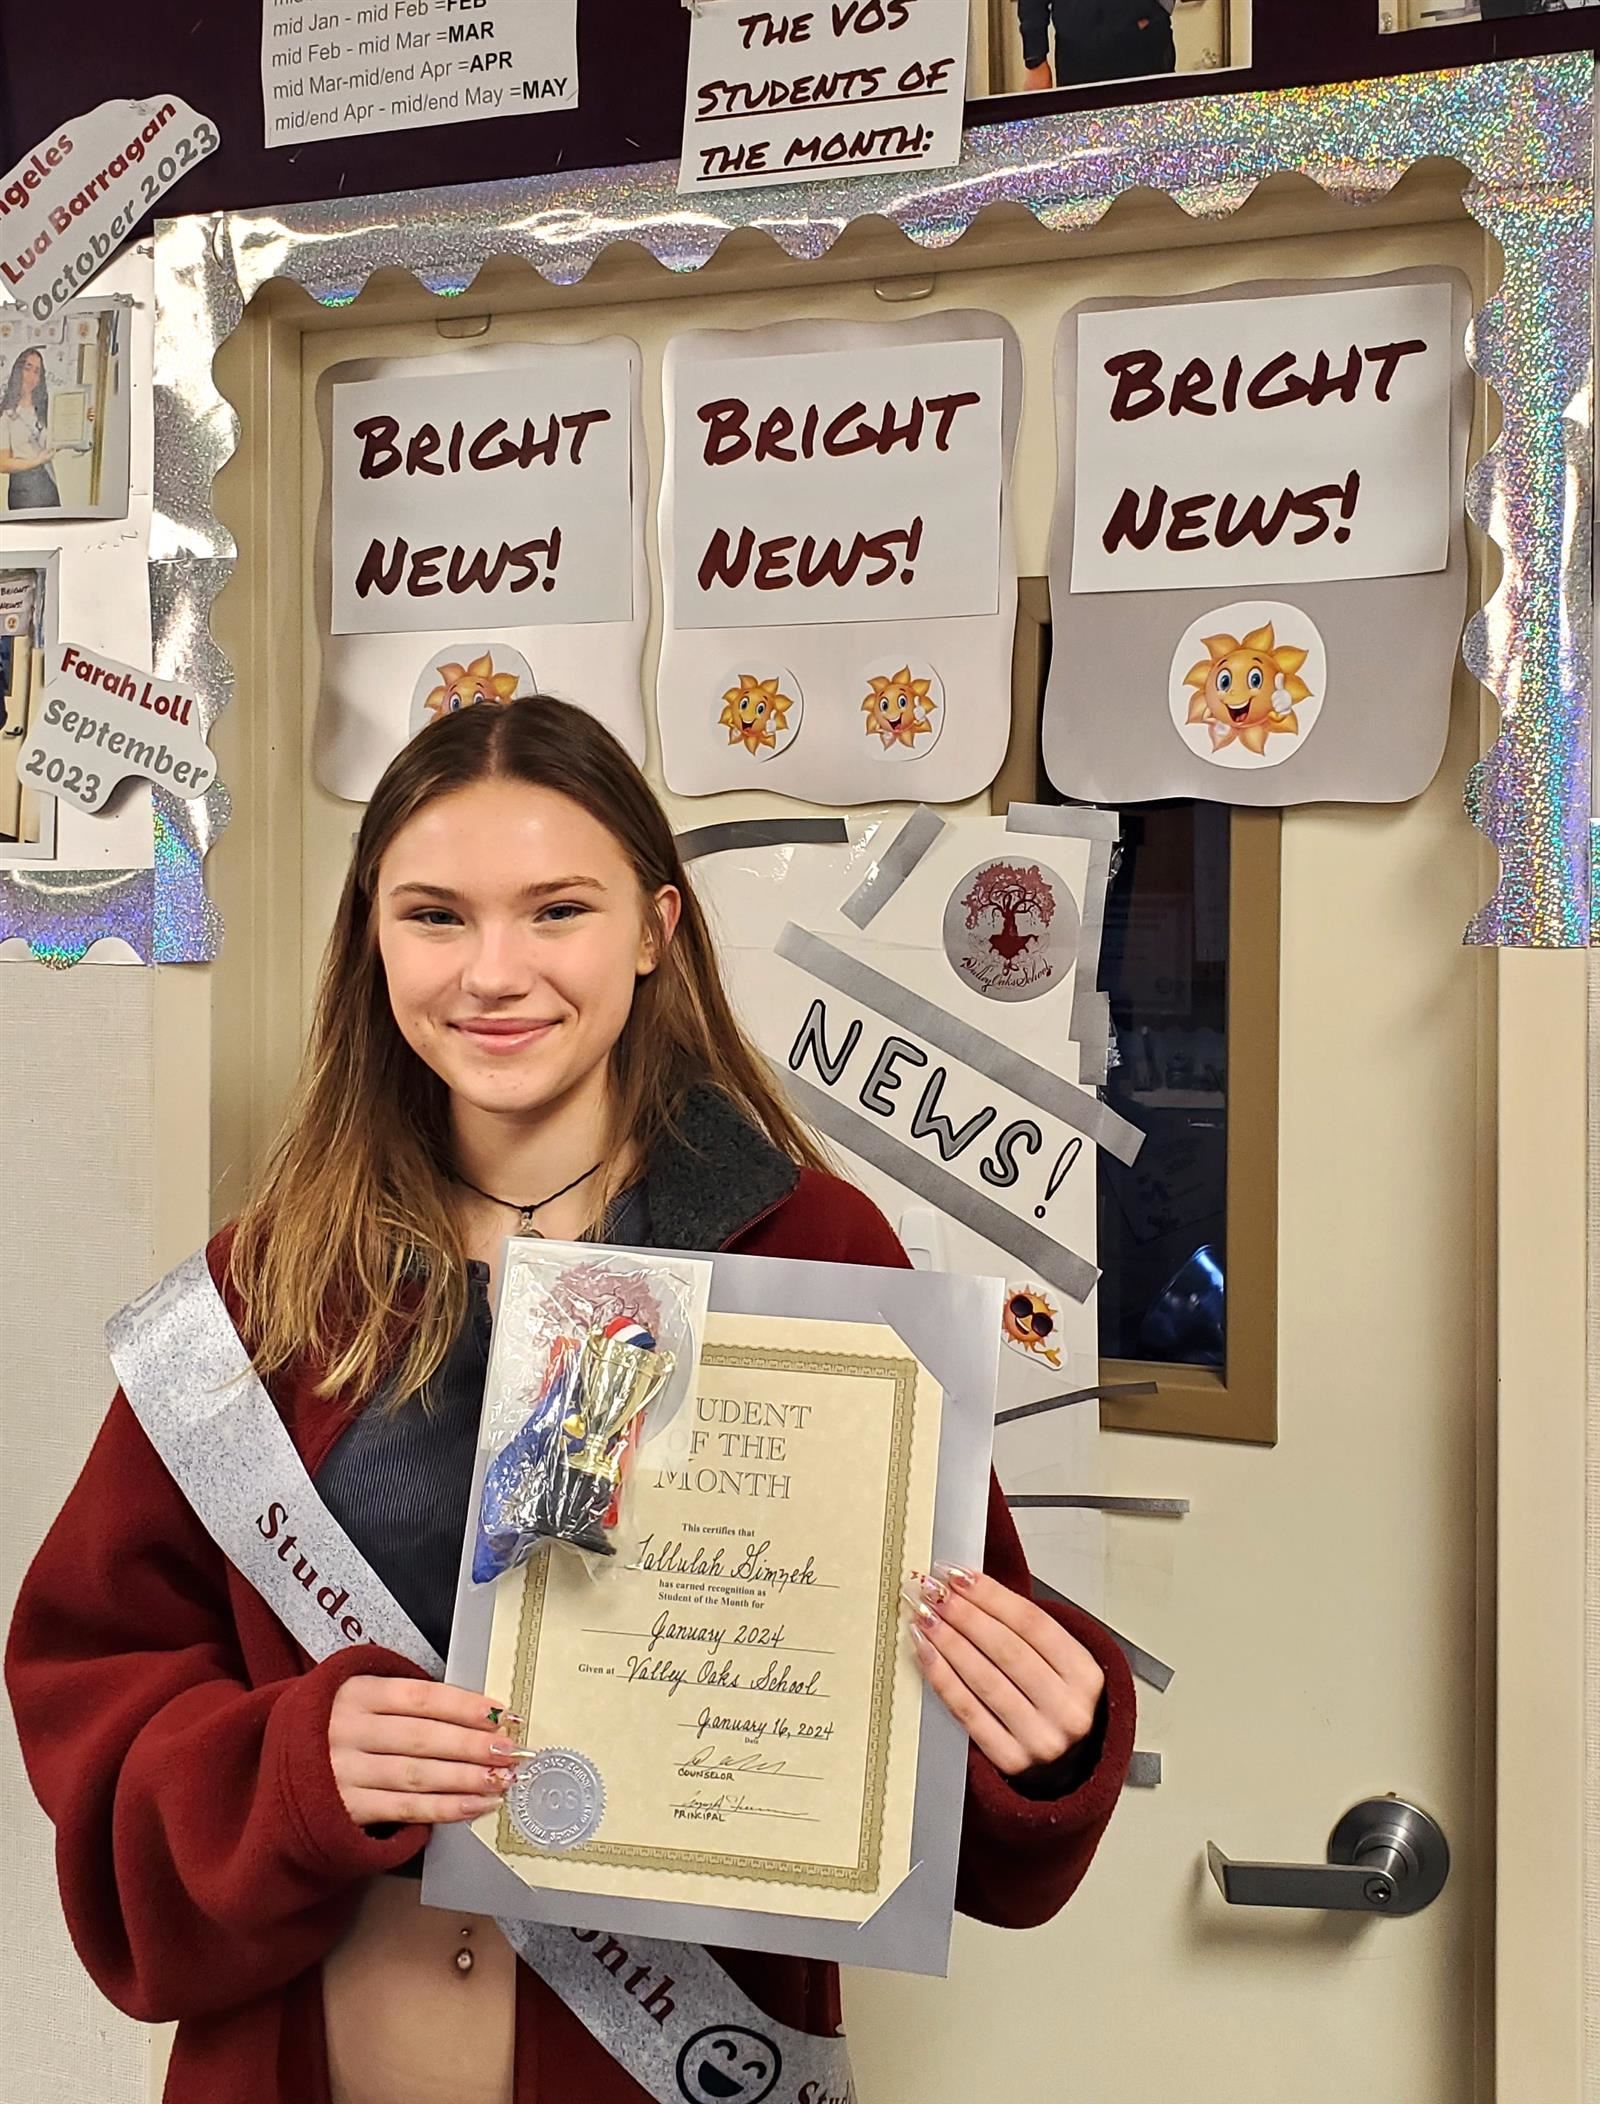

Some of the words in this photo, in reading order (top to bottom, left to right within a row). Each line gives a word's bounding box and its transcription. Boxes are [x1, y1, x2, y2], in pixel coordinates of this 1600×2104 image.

[273, 16, 303, 36] mid
[308, 14, 339, 31] Jan
[357, 3, 388, 24] mid
[395, 0, 428, 19] Feb
[435, 0, 487, 12] =FEB
[738, 12, 814, 49] THE
[831, 0, 918, 37] VOS
[272, 47, 302, 67] mid
[308, 42, 340, 62] Feb
[359, 34, 389, 55] mid
[396, 32, 431, 50] Mar
[436, 21, 495, 43] =MAR
[273, 77, 304, 99] mid
[309, 64, 414, 94] Mar-mid/end
[420, 61, 452, 82] Apr
[458, 51, 513, 73] =APR
[697, 67, 887, 116] STUDENTS
[897, 58, 955, 92] OF
[275, 107, 338, 131] mid/end
[343, 103, 374, 123] Apr
[391, 90, 459, 115] mid/end
[465, 86, 504, 107] May
[510, 77, 568, 99] =MAY
[700, 142, 770, 175] THE
[784, 124, 935, 167] MONTH:
[0, 231, 53, 285] Lua
[48, 103, 176, 235] Barragan
[33, 200, 134, 321] October
[141, 123, 218, 203] 2023
[1104, 339, 1428, 422] BRIGHT
[353, 409, 611, 480] BRIGHT
[697, 392, 981, 466] BRIGHT
[1102, 469, 1360, 554] NEWS!
[355, 526, 562, 599] NEWS!
[697, 516, 923, 591] NEWS!
[60, 648, 136, 702] Farah
[139, 682, 192, 726] Loll
[44, 699, 208, 789] September
[25, 749, 101, 803] 2023
[788, 999, 1083, 1218] NEWS!
[696, 1398, 812, 1429] UDENT
[718, 1433, 787, 1461] THE
[653, 1458, 792, 1500] MONTH
[682, 1523, 700, 1533] This
[702, 1525, 736, 1536] certifies
[738, 1528, 755, 1537] that
[255, 1502, 377, 1645] Stude
[659, 1578, 674, 1588] has
[675, 1582, 705, 1591] earned
[707, 1584, 755, 1595] recognition
[757, 1589, 767, 1597] as
[658, 1592, 692, 1603] Student
[694, 1595, 704, 1604] of
[705, 1596, 719, 1604] the
[720, 1597, 749, 1608] Month
[751, 1600, 765, 1609] for
[648, 1610, 727, 1655] January
[733, 1624, 785, 1648] 2024
[578, 1663, 604, 1674] Given
[605, 1667, 615, 1675] at
[627, 1656, 688, 1697] Valley
[697, 1659, 740, 1688] Oaks
[751, 1660, 821, 1696] School
[697, 1706, 768, 1739] January
[772, 1718, 791, 1740] 16,
[797, 1722, 834, 1740] 2024
[677, 1768, 735, 1781] COUNSELOR
[673, 1809, 726, 1823] PRINCIPAL
